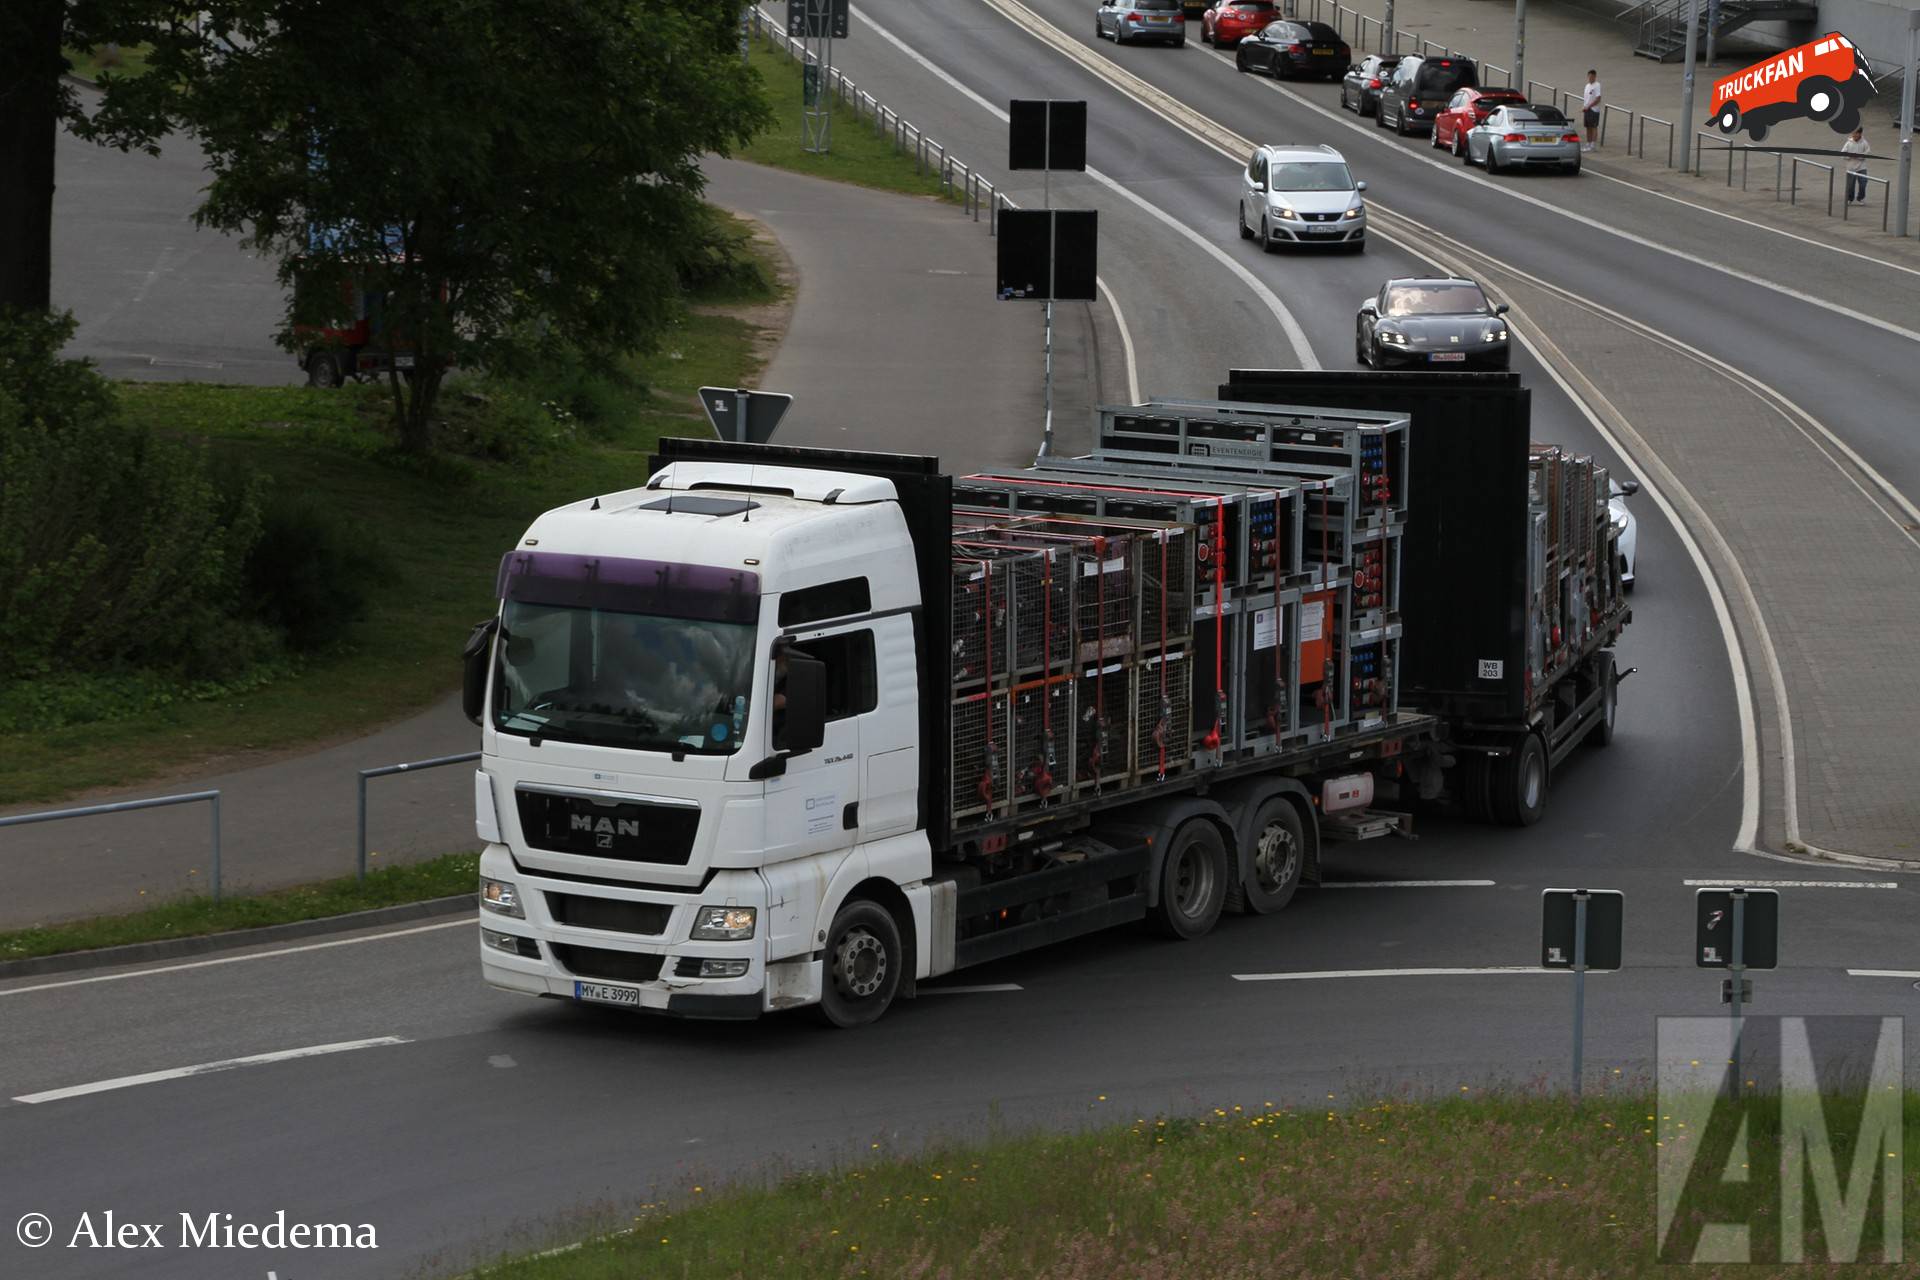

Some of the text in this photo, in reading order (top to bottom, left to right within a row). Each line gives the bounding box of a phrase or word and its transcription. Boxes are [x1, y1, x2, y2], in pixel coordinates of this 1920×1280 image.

[1483, 669, 1498, 677] 203
[570, 813, 640, 837] MAN
[582, 985, 637, 1002] MY E 3999
